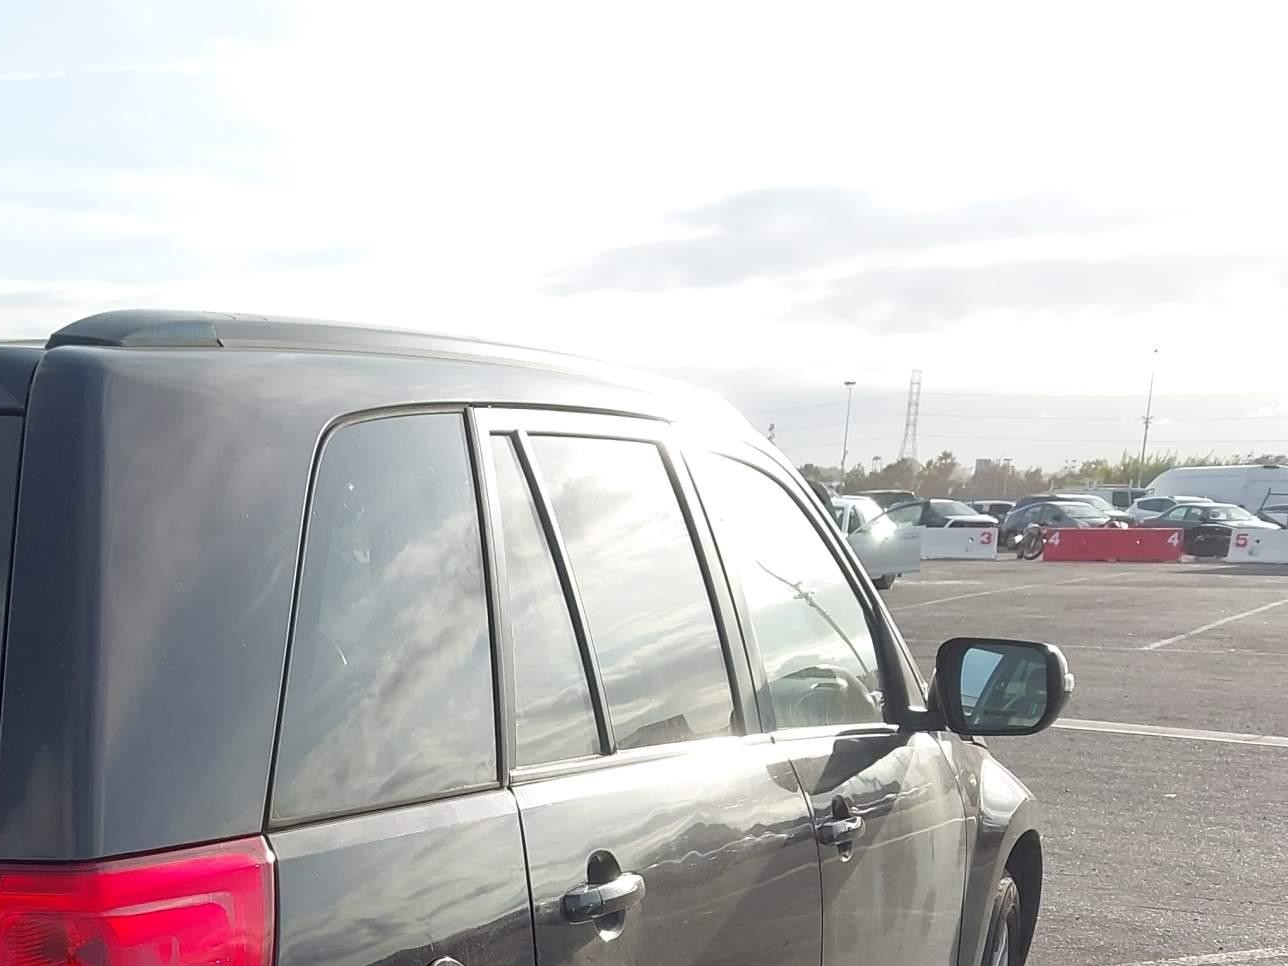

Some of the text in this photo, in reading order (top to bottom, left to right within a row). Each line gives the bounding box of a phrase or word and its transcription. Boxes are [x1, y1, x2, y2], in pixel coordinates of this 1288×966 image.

[980, 532, 992, 545] 3
[1048, 531, 1179, 546] 4 4
[1235, 533, 1248, 548] 5
